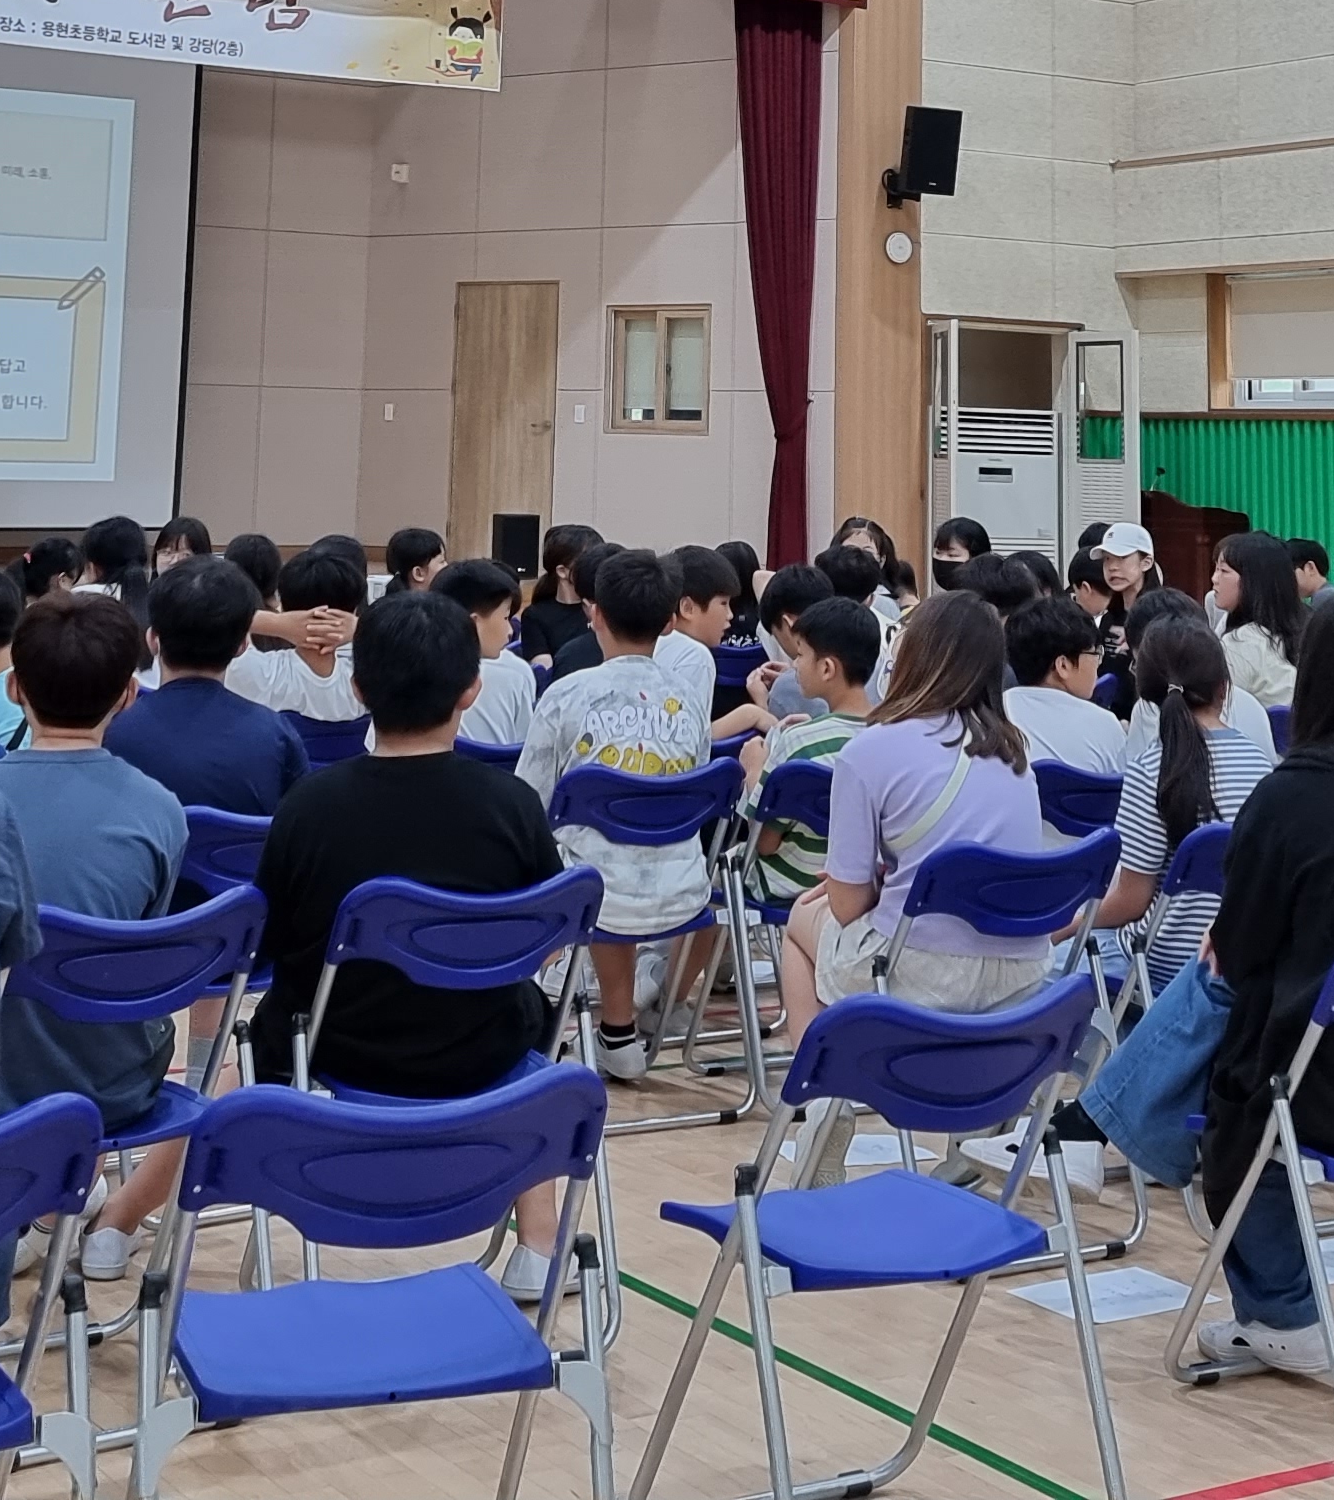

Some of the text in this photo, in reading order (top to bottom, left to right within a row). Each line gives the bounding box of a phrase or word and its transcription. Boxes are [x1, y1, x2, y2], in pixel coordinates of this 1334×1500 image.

[41, 20, 123, 45] 용현초등학교
[126, 30, 168, 50] 도서관
[170, 36, 184, 52] 및
[188, 36, 244, 58] 강당(2층)
[586, 704, 693, 743] ARCHIVE
